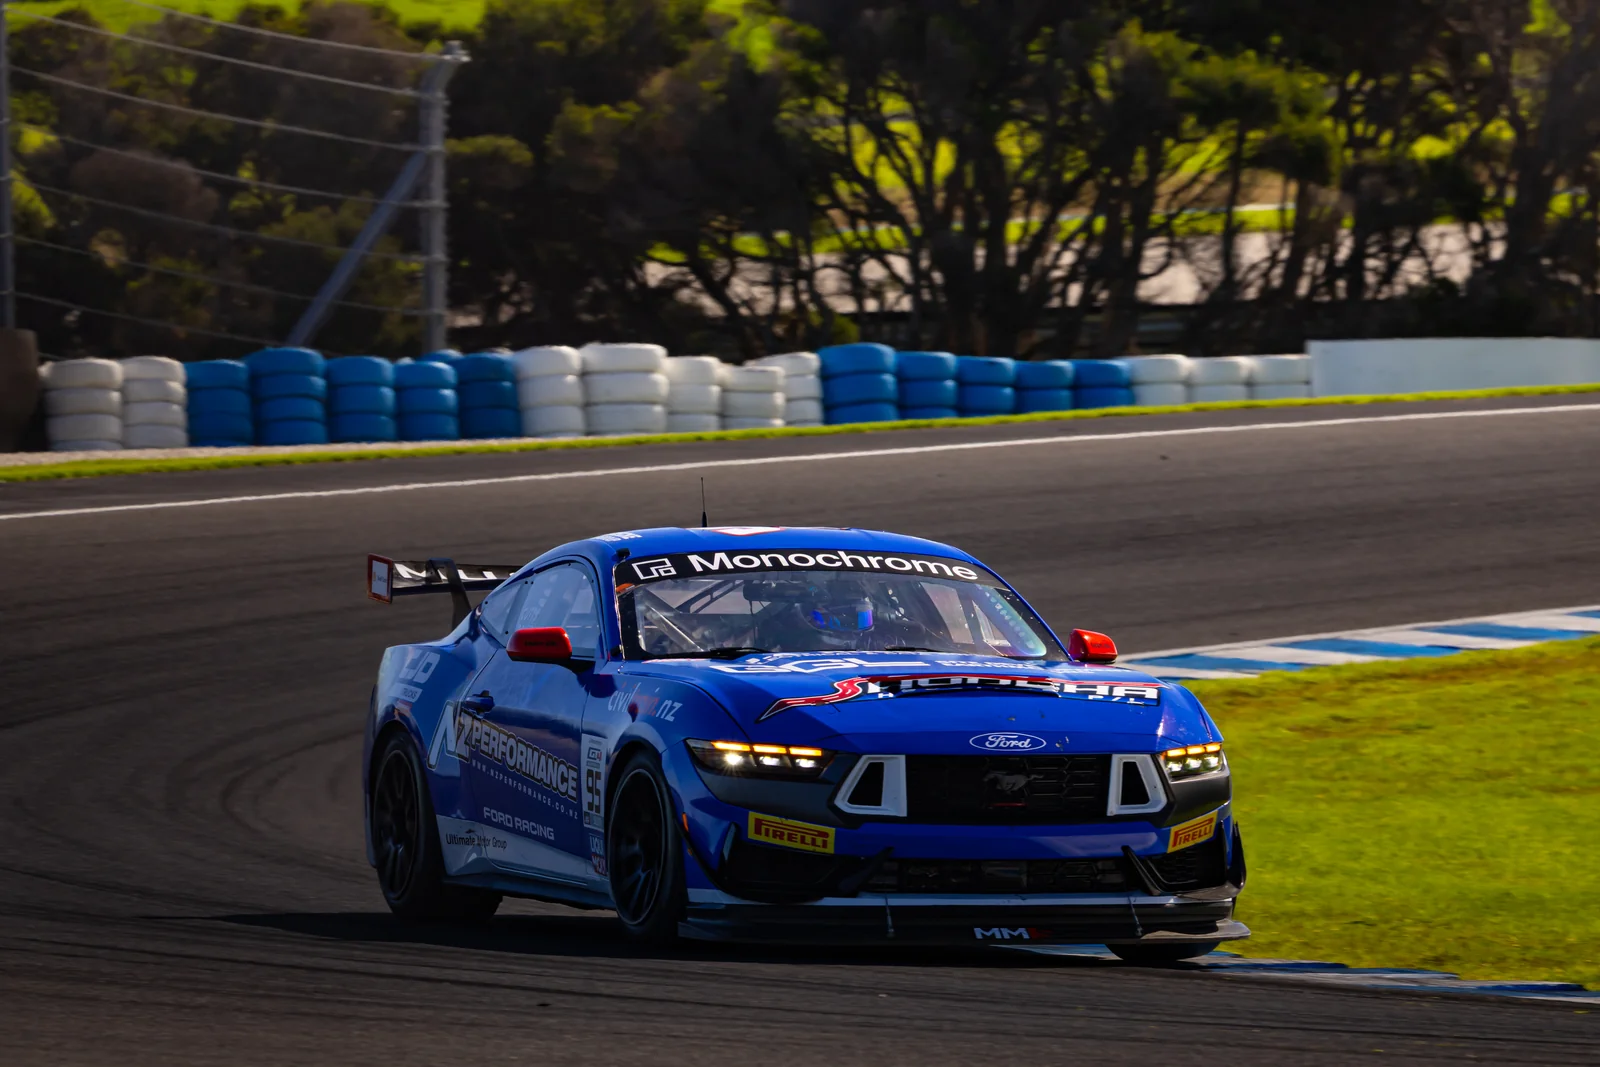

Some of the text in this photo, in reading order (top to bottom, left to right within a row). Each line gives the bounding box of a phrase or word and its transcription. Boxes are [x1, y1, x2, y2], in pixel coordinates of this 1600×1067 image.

[687, 550, 979, 580] Monochrome
[984, 735, 1032, 749] Ford
[586, 768, 602, 814] 95
[483, 806, 555, 841] FORD RACING
[753, 817, 830, 849] PIRELLI
[1171, 816, 1215, 849] PIRELLI
[445, 832, 476, 847] Ultimate
[491, 836, 508, 852] Group
